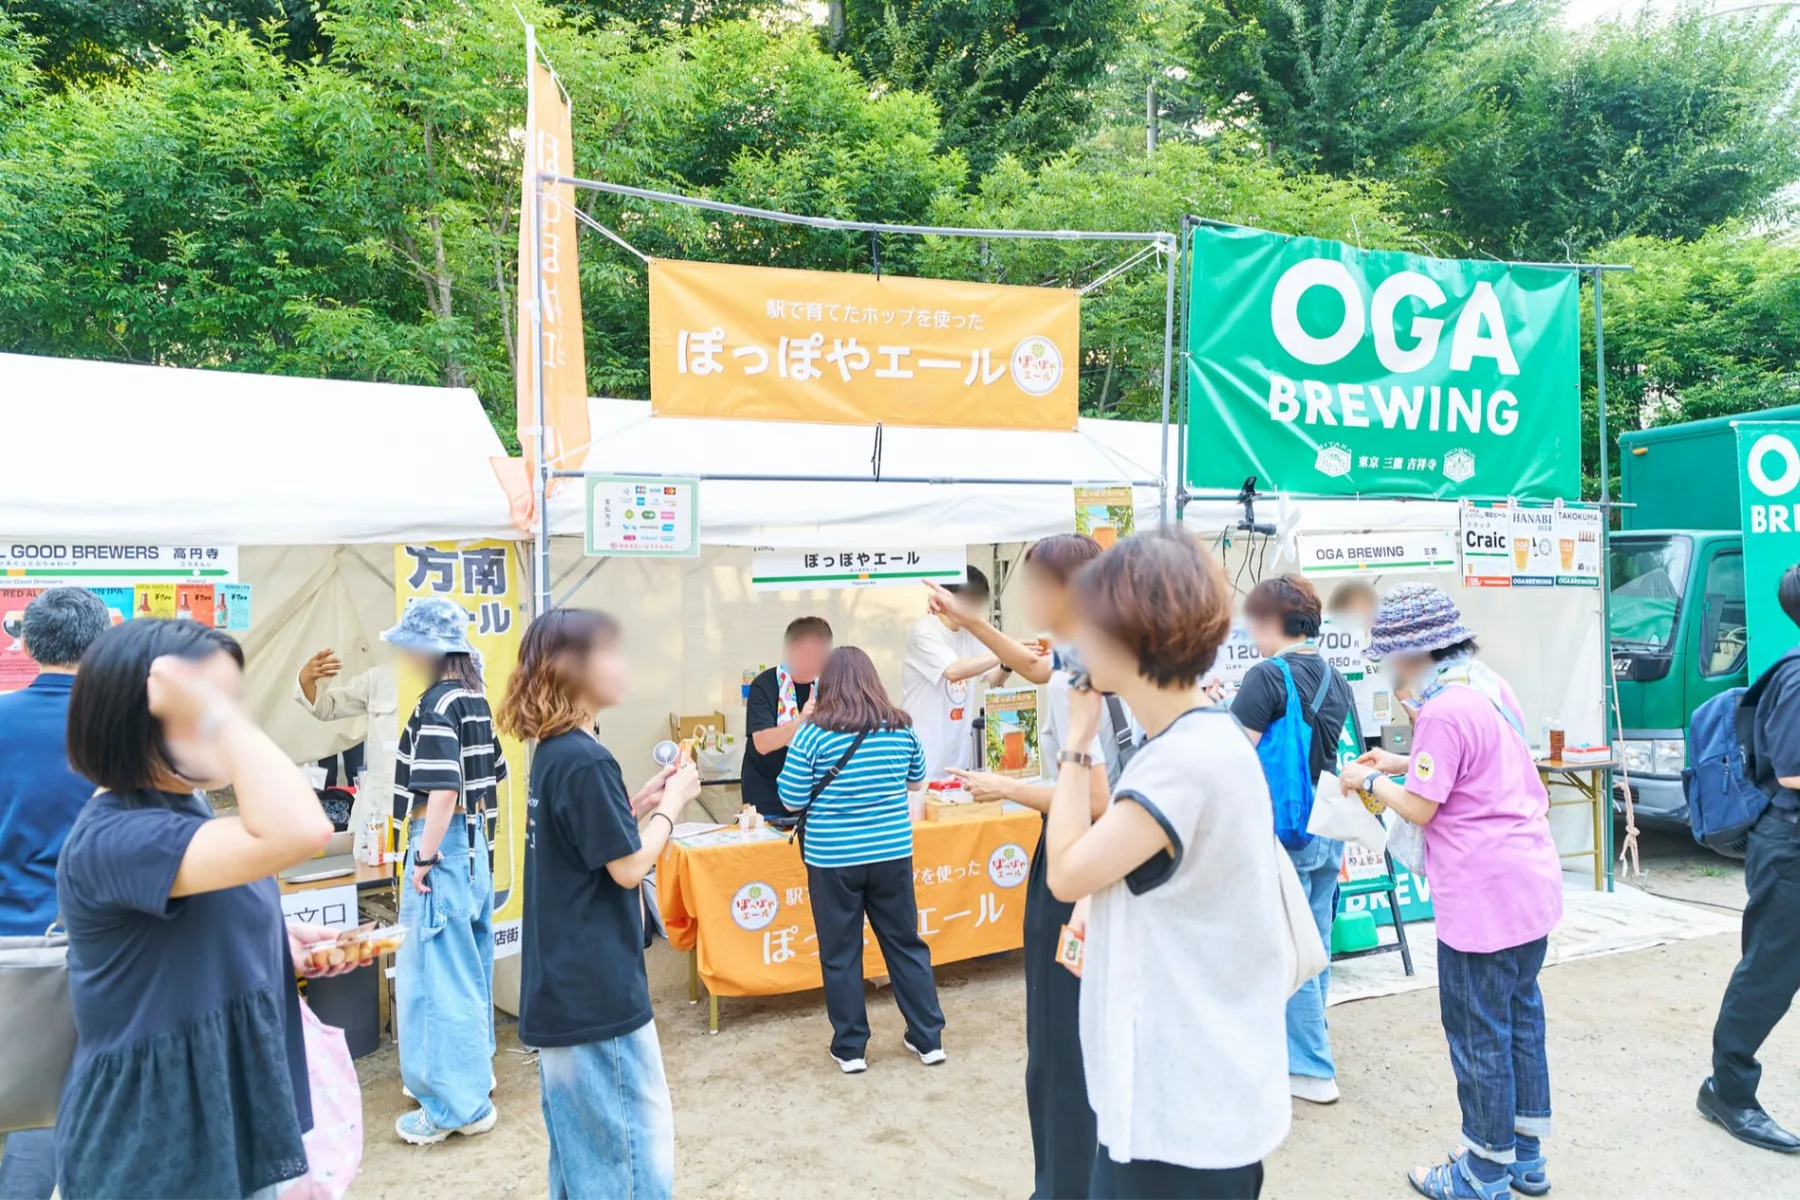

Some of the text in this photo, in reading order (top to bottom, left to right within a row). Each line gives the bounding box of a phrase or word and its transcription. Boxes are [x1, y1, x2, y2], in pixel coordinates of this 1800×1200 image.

[766, 298, 985, 331] 駅で育てたホップを使った
[1271, 258, 1520, 375] OGA
[677, 326, 1007, 387] ぽっぽやエール
[1269, 376, 1520, 436] BREWING
[1358, 456, 1379, 468] 東京
[1407, 458, 1437, 471] 吉祥寺
[1747, 434, 1800, 497] O
[1513, 513, 1552, 525] HANABI
[1558, 511, 1599, 521] TAKOKUMA
[1466, 530, 1506, 548] Craic
[11, 544, 67, 559] GOOD
[72, 545, 160, 560] BREWERS
[173, 547, 219, 560] 高円寺
[804, 551, 920, 568] ぽっぽやエール
[1316, 546, 1404, 560] OGA BREWING
[405, 545, 506, 595] 方南
[3, 588, 24, 597] RED
[107, 587, 124, 595] IPA
[1227, 644, 1262, 660] 120
[917, 892, 1005, 936] エール
